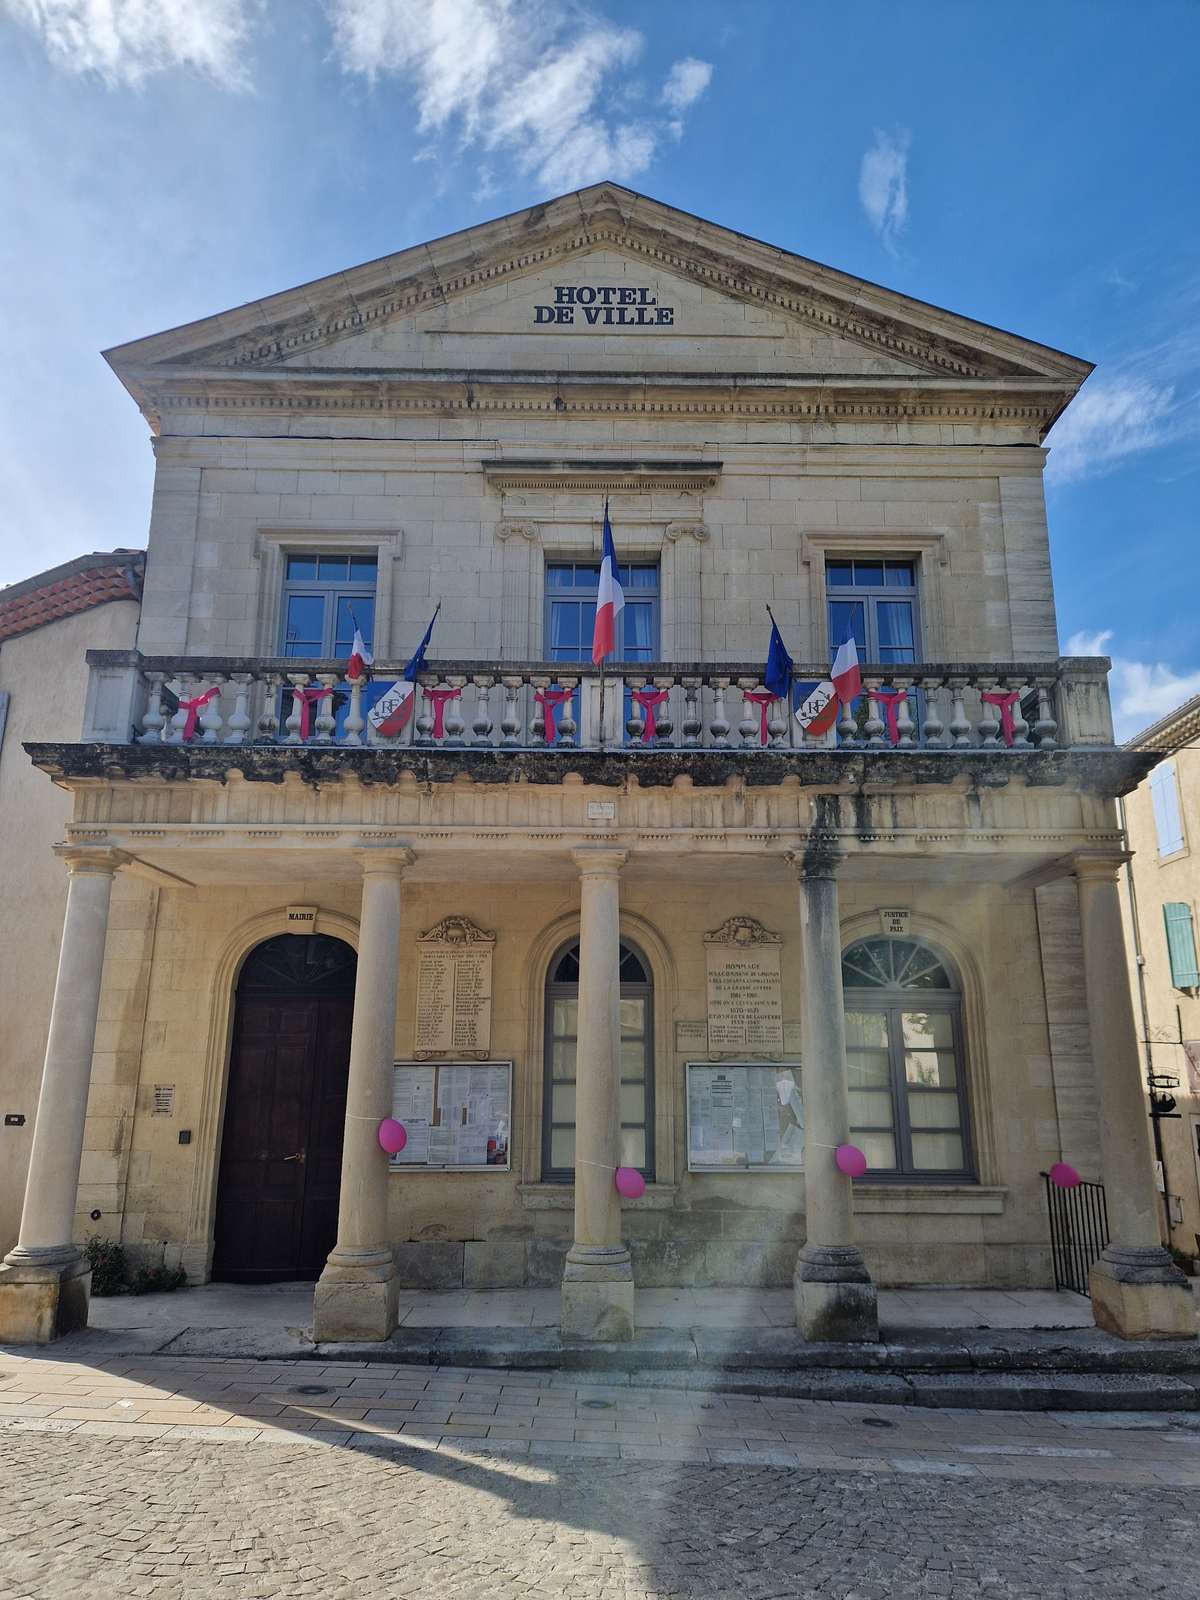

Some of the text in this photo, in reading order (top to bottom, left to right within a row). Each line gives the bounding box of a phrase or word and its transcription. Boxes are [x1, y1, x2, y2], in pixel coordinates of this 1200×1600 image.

[553, 286, 657, 306] HOTEL
[533, 305, 674, 326] DE VILLE
[382, 698, 400, 714] RF
[808, 699, 825, 714] RF
[288, 913, 314, 921] MAIRIE
